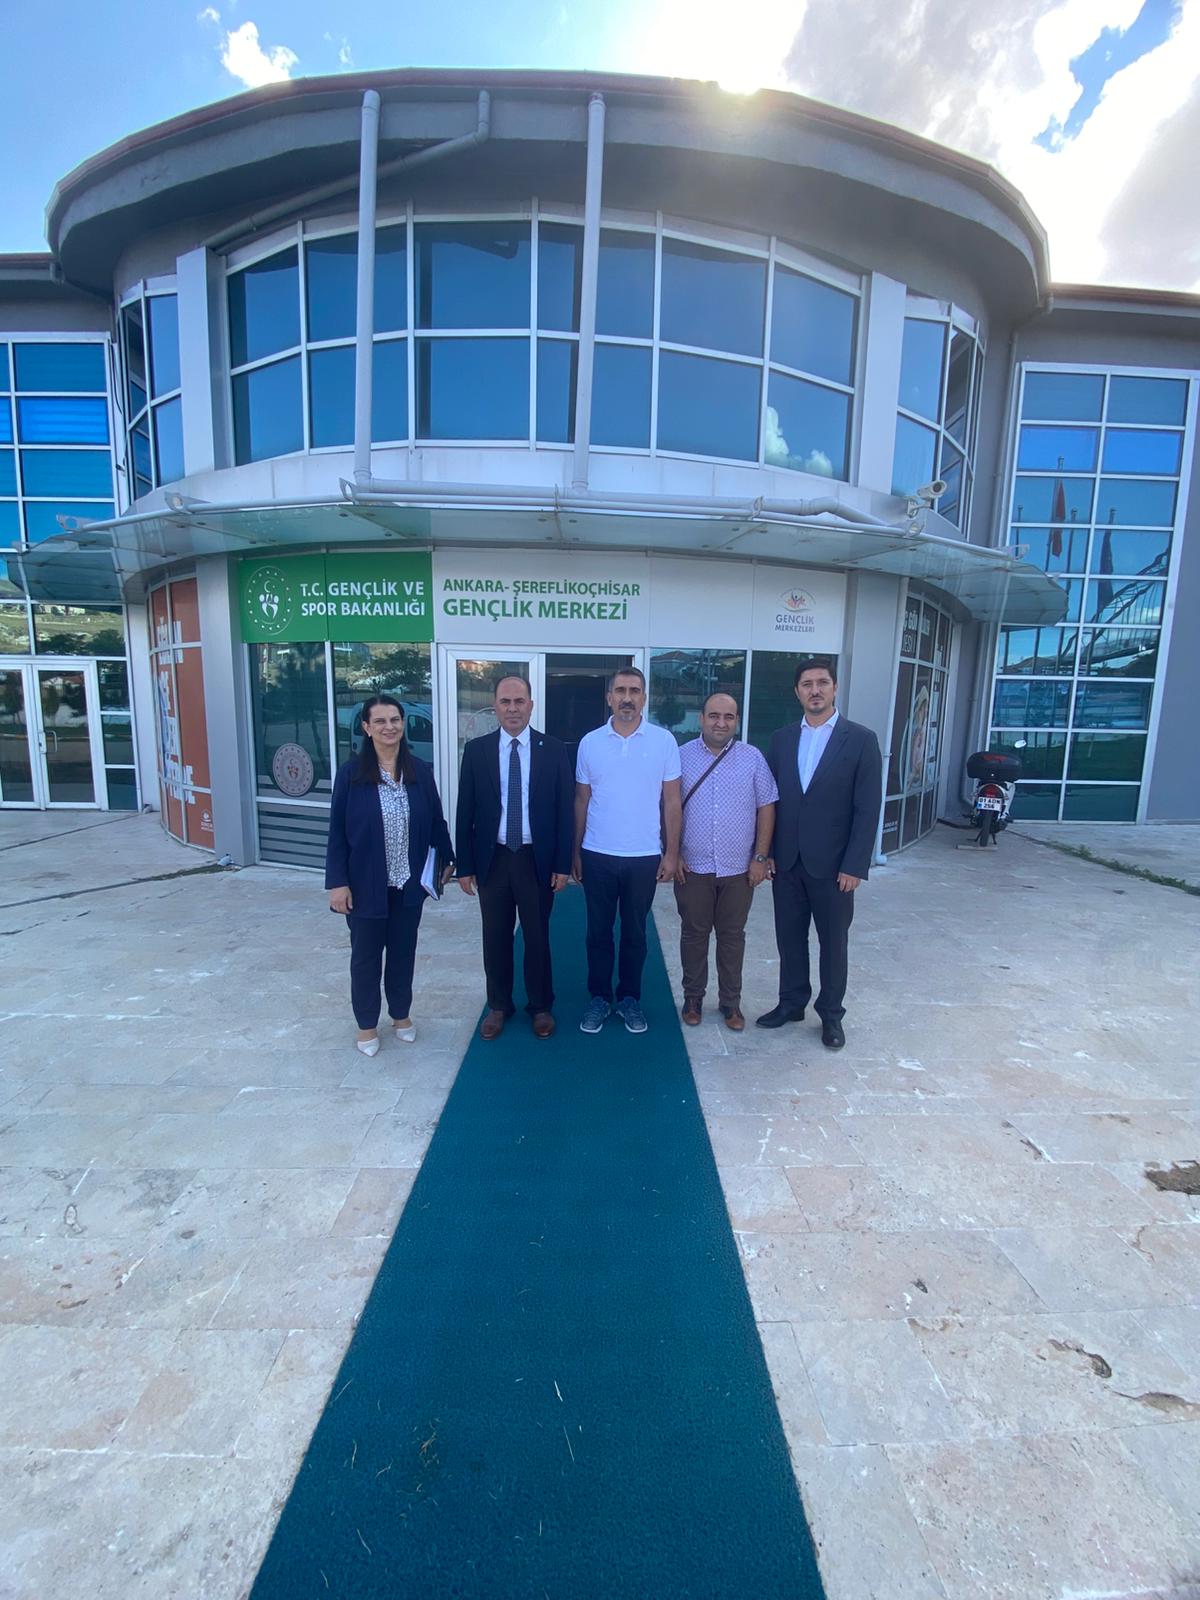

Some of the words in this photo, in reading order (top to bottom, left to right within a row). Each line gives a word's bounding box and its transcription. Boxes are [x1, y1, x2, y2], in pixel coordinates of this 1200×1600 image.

[300, 583, 324, 596] T.C.
[328, 578, 398, 599] GENÇLİK
[403, 581, 424, 595] VE
[443, 578, 509, 592] ANKARA-
[512, 579, 640, 598] ŞEREFLİKOÇHİSAR
[301, 602, 337, 616] SPOR
[341, 599, 425, 616] BAKANLIĞI
[443, 596, 533, 622] GENÇLİK
[538, 599, 627, 620] MERKEZİ
